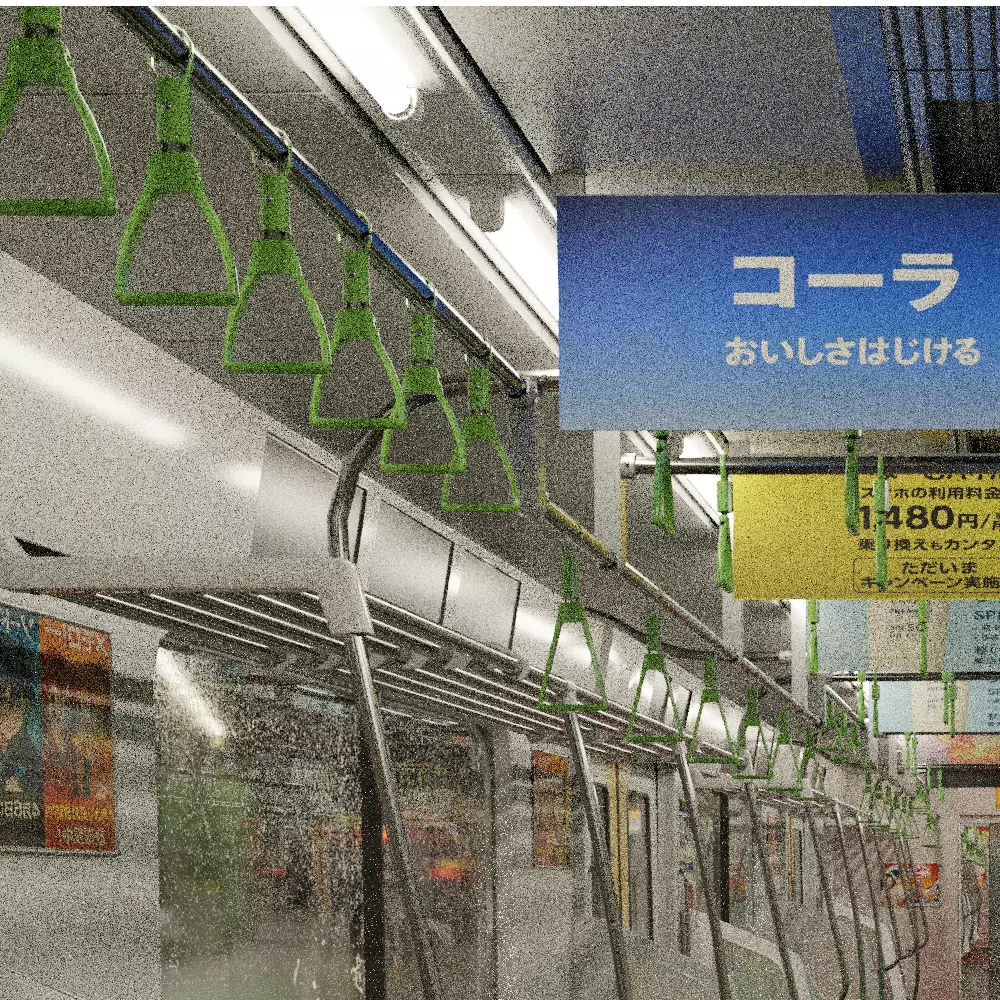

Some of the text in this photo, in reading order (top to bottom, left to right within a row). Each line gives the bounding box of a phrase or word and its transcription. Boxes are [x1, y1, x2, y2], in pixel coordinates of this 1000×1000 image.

[732, 252, 960, 312] コーラ
[724, 335, 981, 367] おいしさはじける
[901, 561, 978, 575] ただいま
